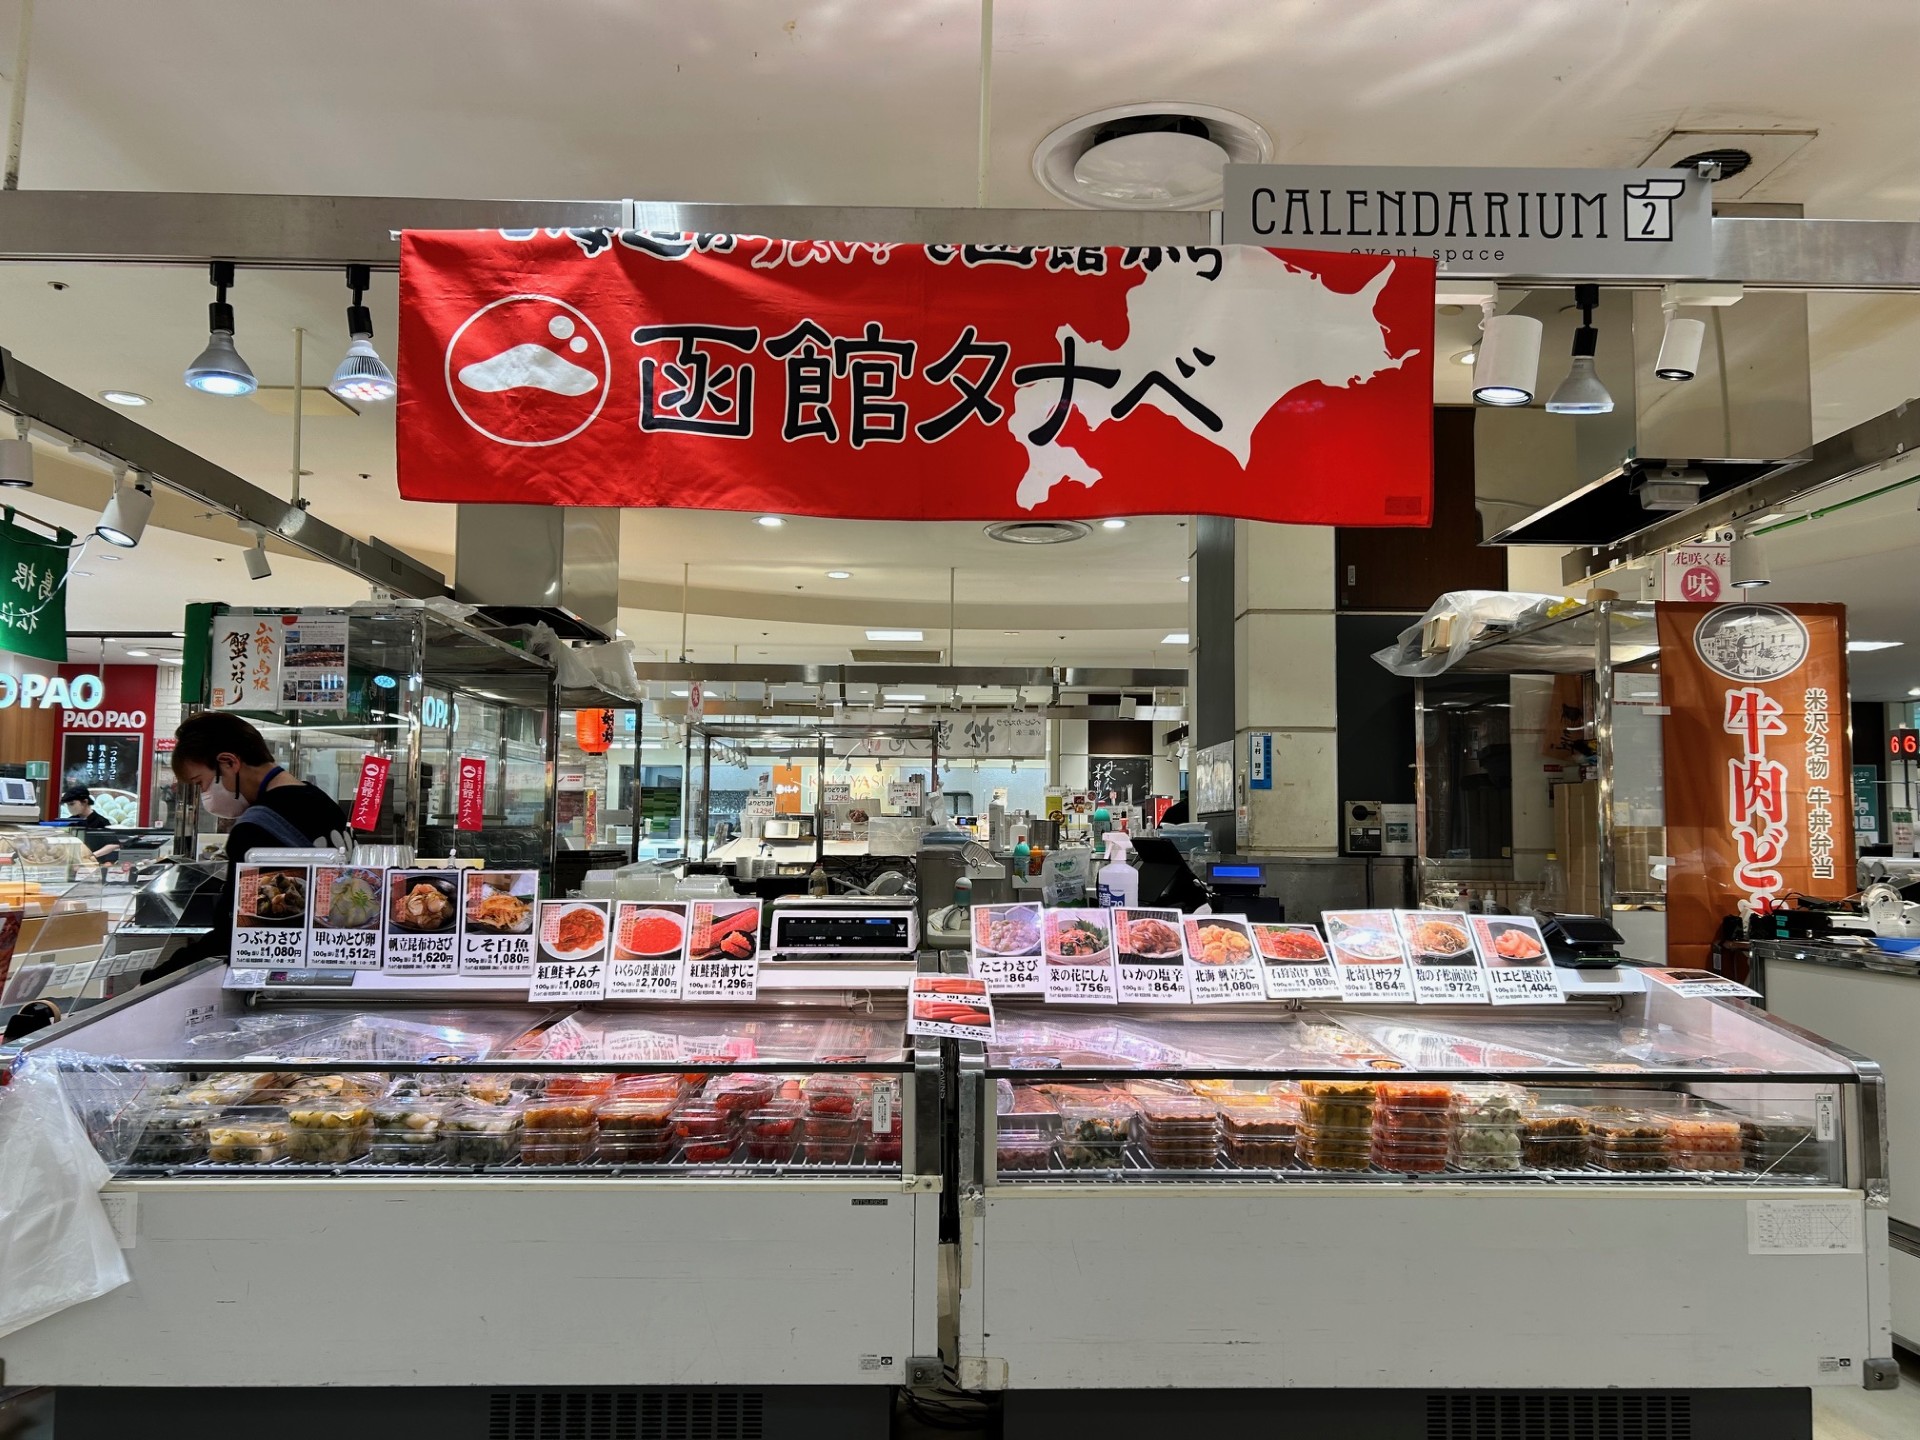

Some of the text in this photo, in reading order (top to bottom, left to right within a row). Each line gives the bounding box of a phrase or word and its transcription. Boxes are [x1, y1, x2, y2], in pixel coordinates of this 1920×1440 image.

[1251, 188, 1656, 239] CALENDARIUM 2
[1432, 248, 1505, 262] space
[631, 318, 1224, 450] 函館タナベ
[1687, 573, 1714, 597] 味
[63, 710, 146, 729] PAOPAO
[1804, 687, 1834, 880] 米沢名物 牛丼弁当
[356, 777, 375, 824] 函館タナベ
[462, 779, 474, 825] 函館タナベ
[238, 931, 302, 946] つぶわさび
[315, 931, 376, 947] 甲いかとび卵
[388, 937, 454, 952] 帆立昆布わさび
[466, 938, 530, 952] しそ白魚
[537, 965, 601, 980] 紅鮭キムチ
[614, 963, 677, 978] いくらの醤油漬け
[690, 963, 754, 978] 紅鮭醤油すじこ
[979, 960, 1038, 973] たこわさび
[1050, 968, 1108, 982] 菜の花にしん
[1122, 968, 1183, 982] いかの塩辛
